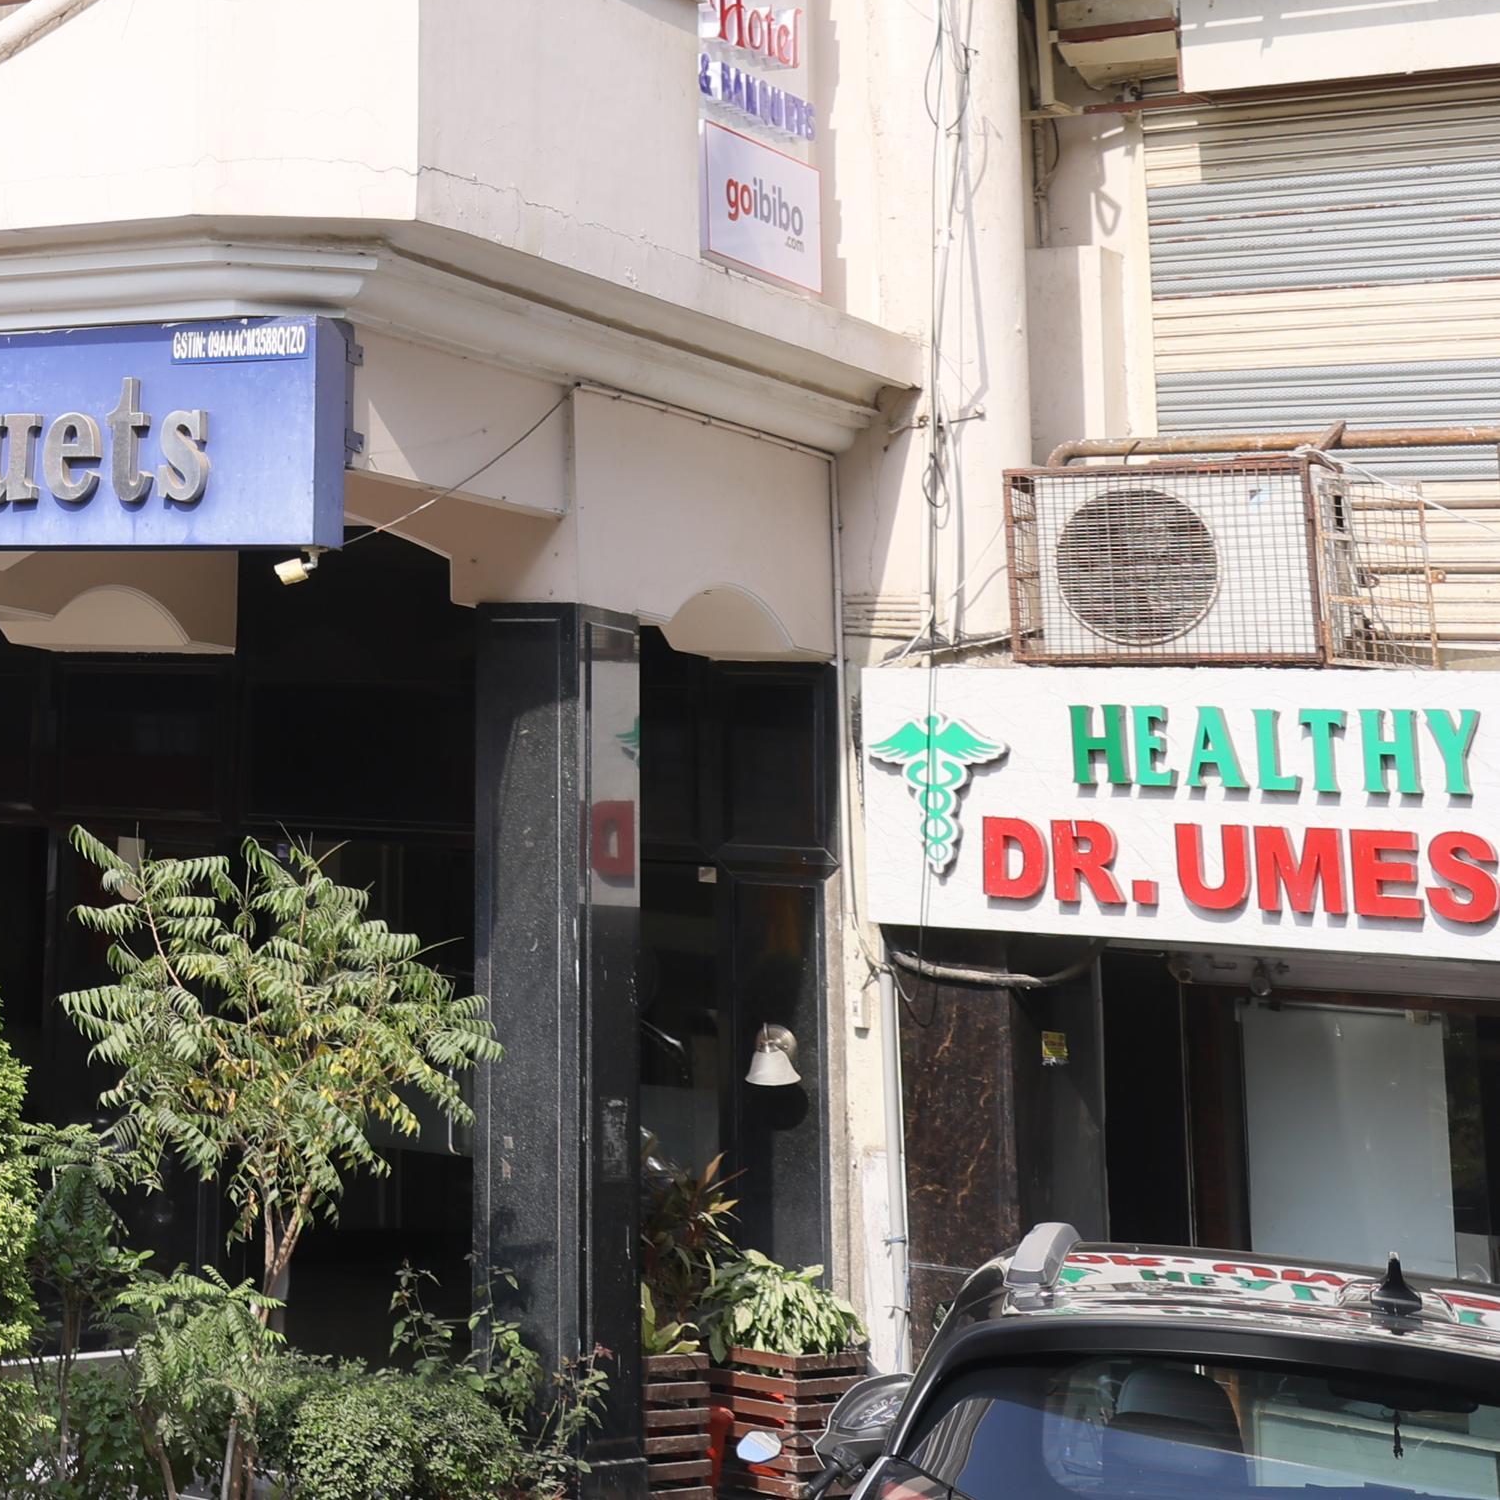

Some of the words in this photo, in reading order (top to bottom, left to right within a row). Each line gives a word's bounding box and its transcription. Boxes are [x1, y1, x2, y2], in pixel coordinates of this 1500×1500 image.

[699, 52, 713, 98] &
[721, 60, 817, 141] BANQUETS
[726, 177, 804, 236] goibibo
[785, 235, 805, 254] .com
[1068, 704, 1481, 796] HEALTHY
